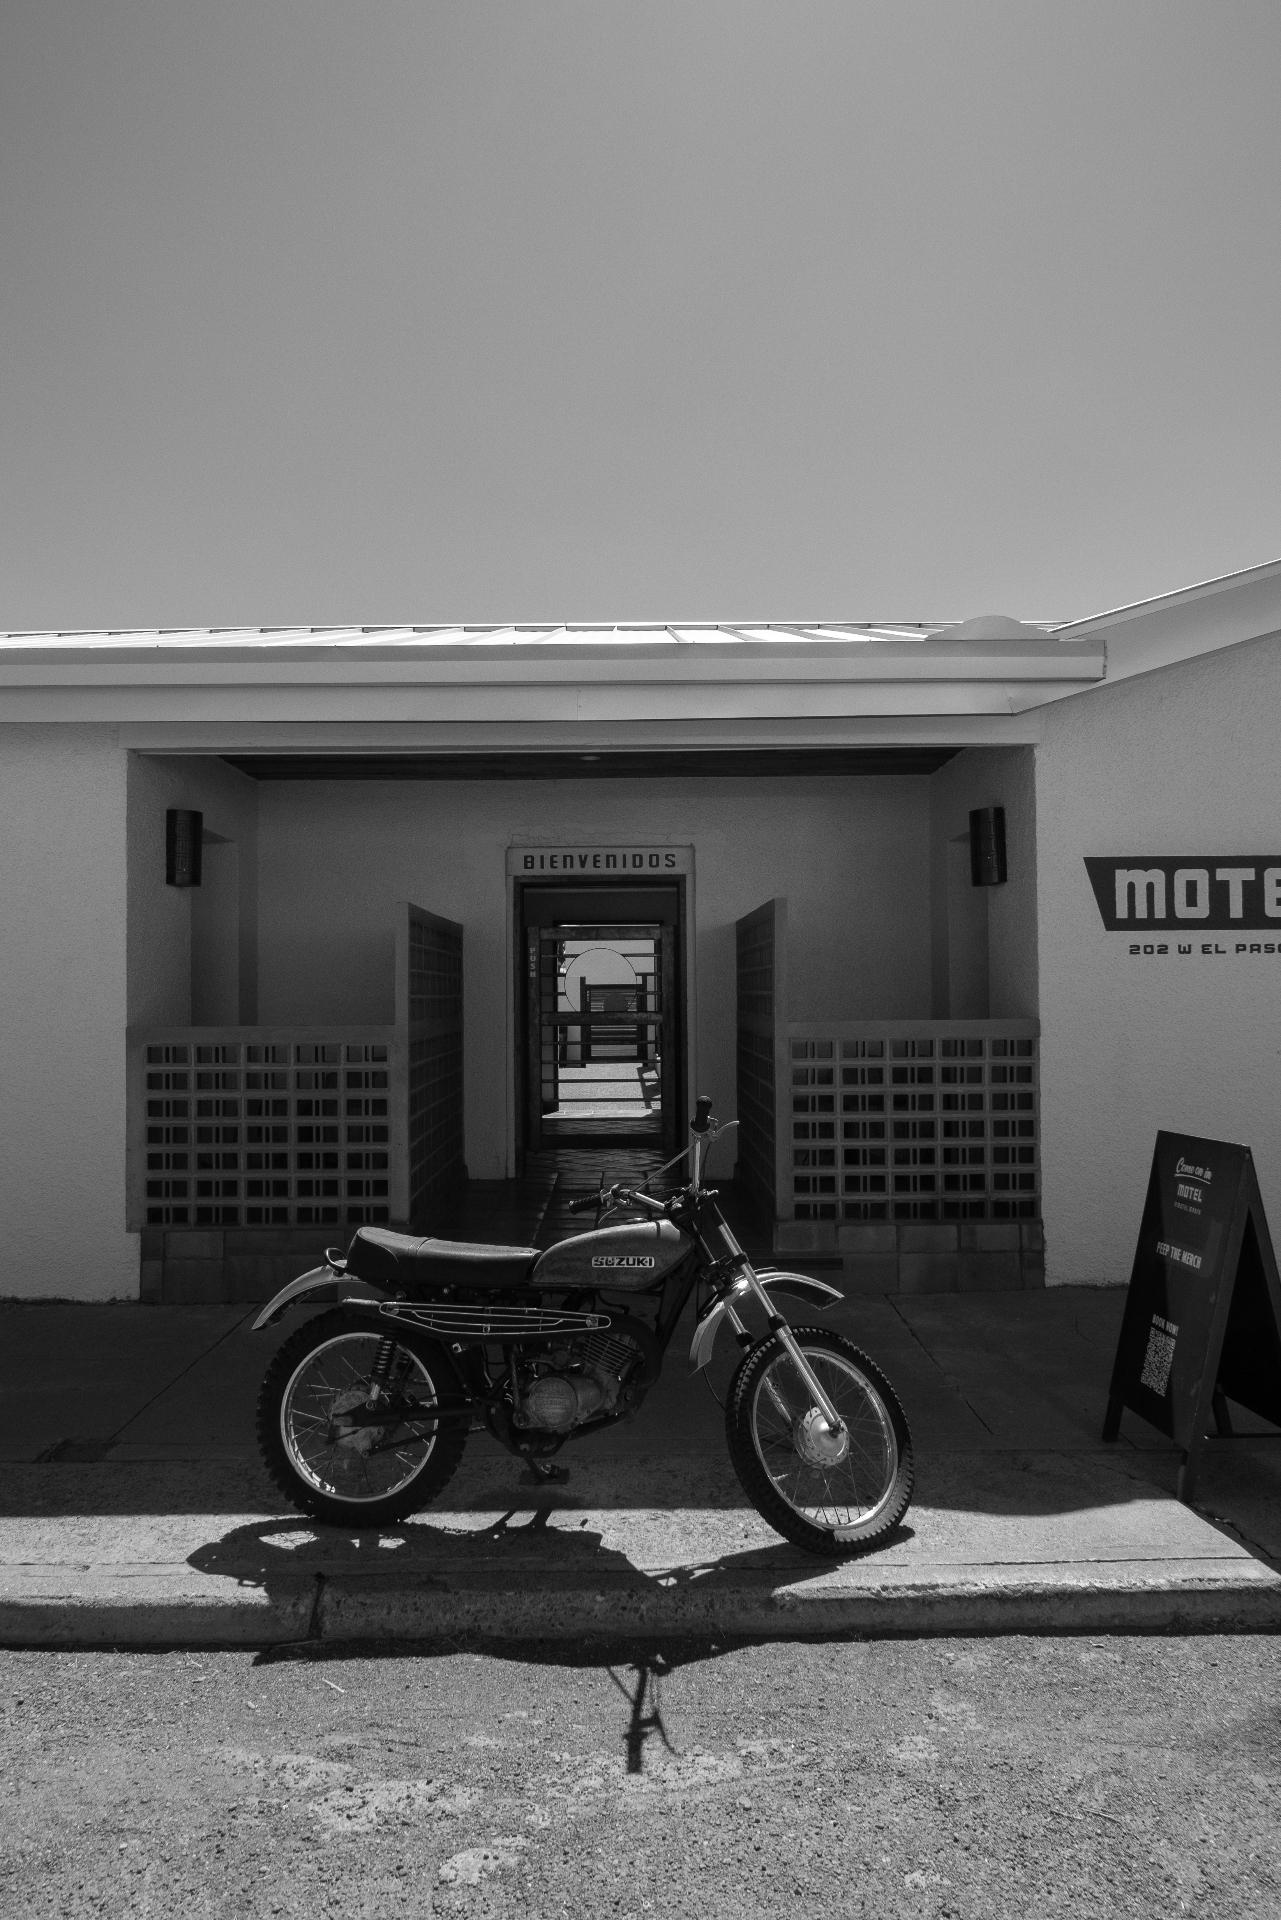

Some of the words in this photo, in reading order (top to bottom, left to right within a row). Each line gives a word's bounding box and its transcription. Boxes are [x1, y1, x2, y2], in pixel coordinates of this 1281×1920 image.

[523, 853, 676, 869] BIENVENIDOS
[1128, 944, 1169, 955] 202
[1177, 943, 1192, 955] W
[1201, 943, 1226, 955] EL
[1175, 1156, 1195, 1174] Come
[1194, 1165, 1204, 1177] on
[1203, 1167, 1213, 1180] in
[1177, 1183, 1202, 1203] MOTEL
[592, 1256, 654, 1267] SUZUKI
[1156, 1241, 1170, 1256] PEEP
[1170, 1245, 1182, 1261] THE
[1181, 1250, 1202, 1269] MERCH
[1152, 1313, 1165, 1330] BOOK
